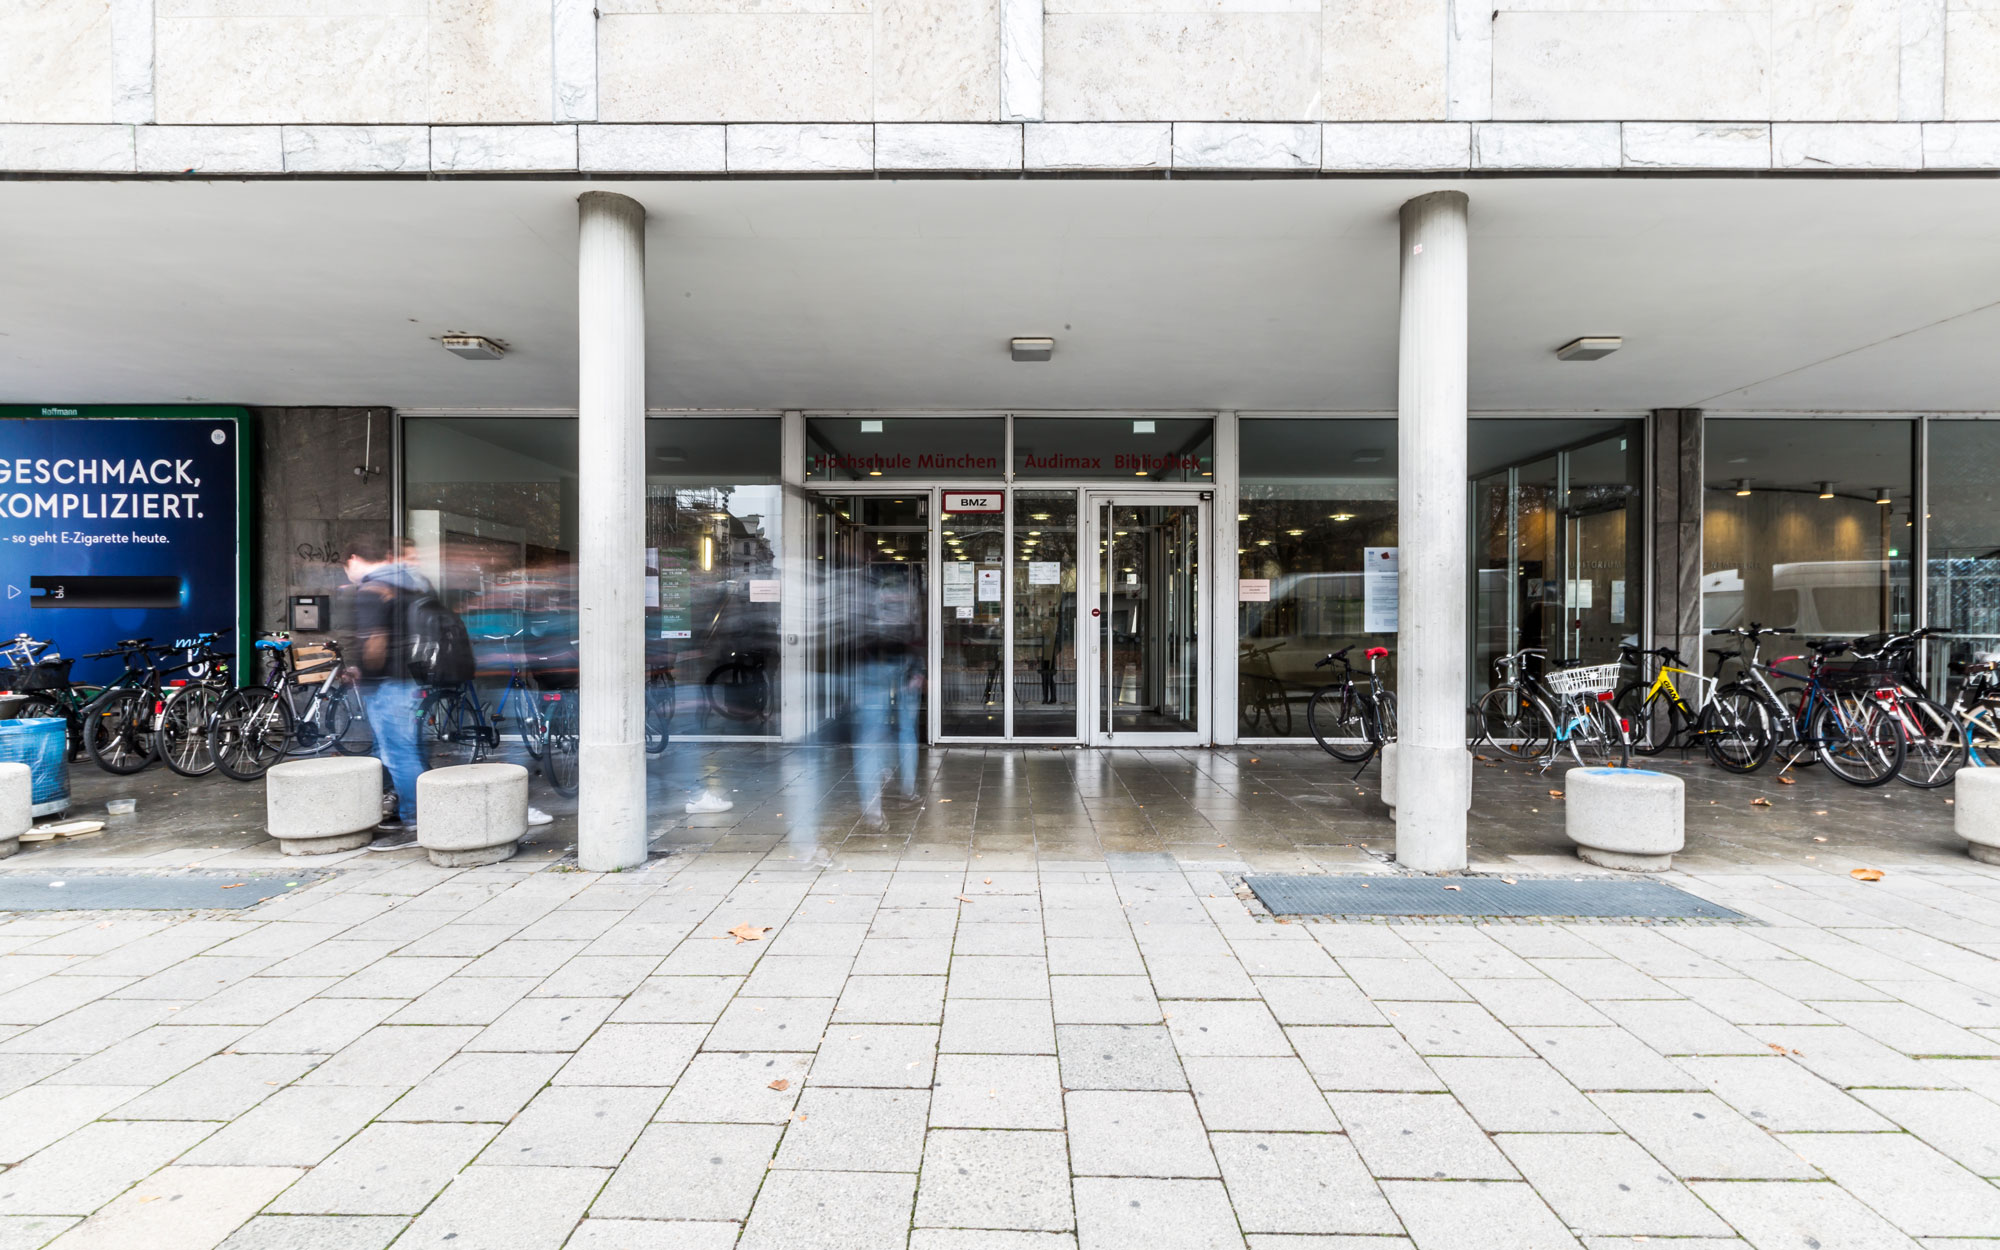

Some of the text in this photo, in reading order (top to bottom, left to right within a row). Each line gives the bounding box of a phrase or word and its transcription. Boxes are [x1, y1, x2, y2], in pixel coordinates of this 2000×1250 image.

[42, 407, 78, 416] Hoffmann
[814, 453, 997, 469] Hochschule München
[1024, 453, 1201, 470] Audimax Bibliothek
[0, 458, 201, 487] GESCHMACK,
[960, 498, 988, 507] BMZ
[12, 534, 26, 543] so
[29, 531, 58, 546] geht
[61, 532, 129, 547] E-Zigarette
[132, 531, 170, 544] heute.
[54, 585, 64, 599] blu
[1662, 680, 1679, 700] GIAN
